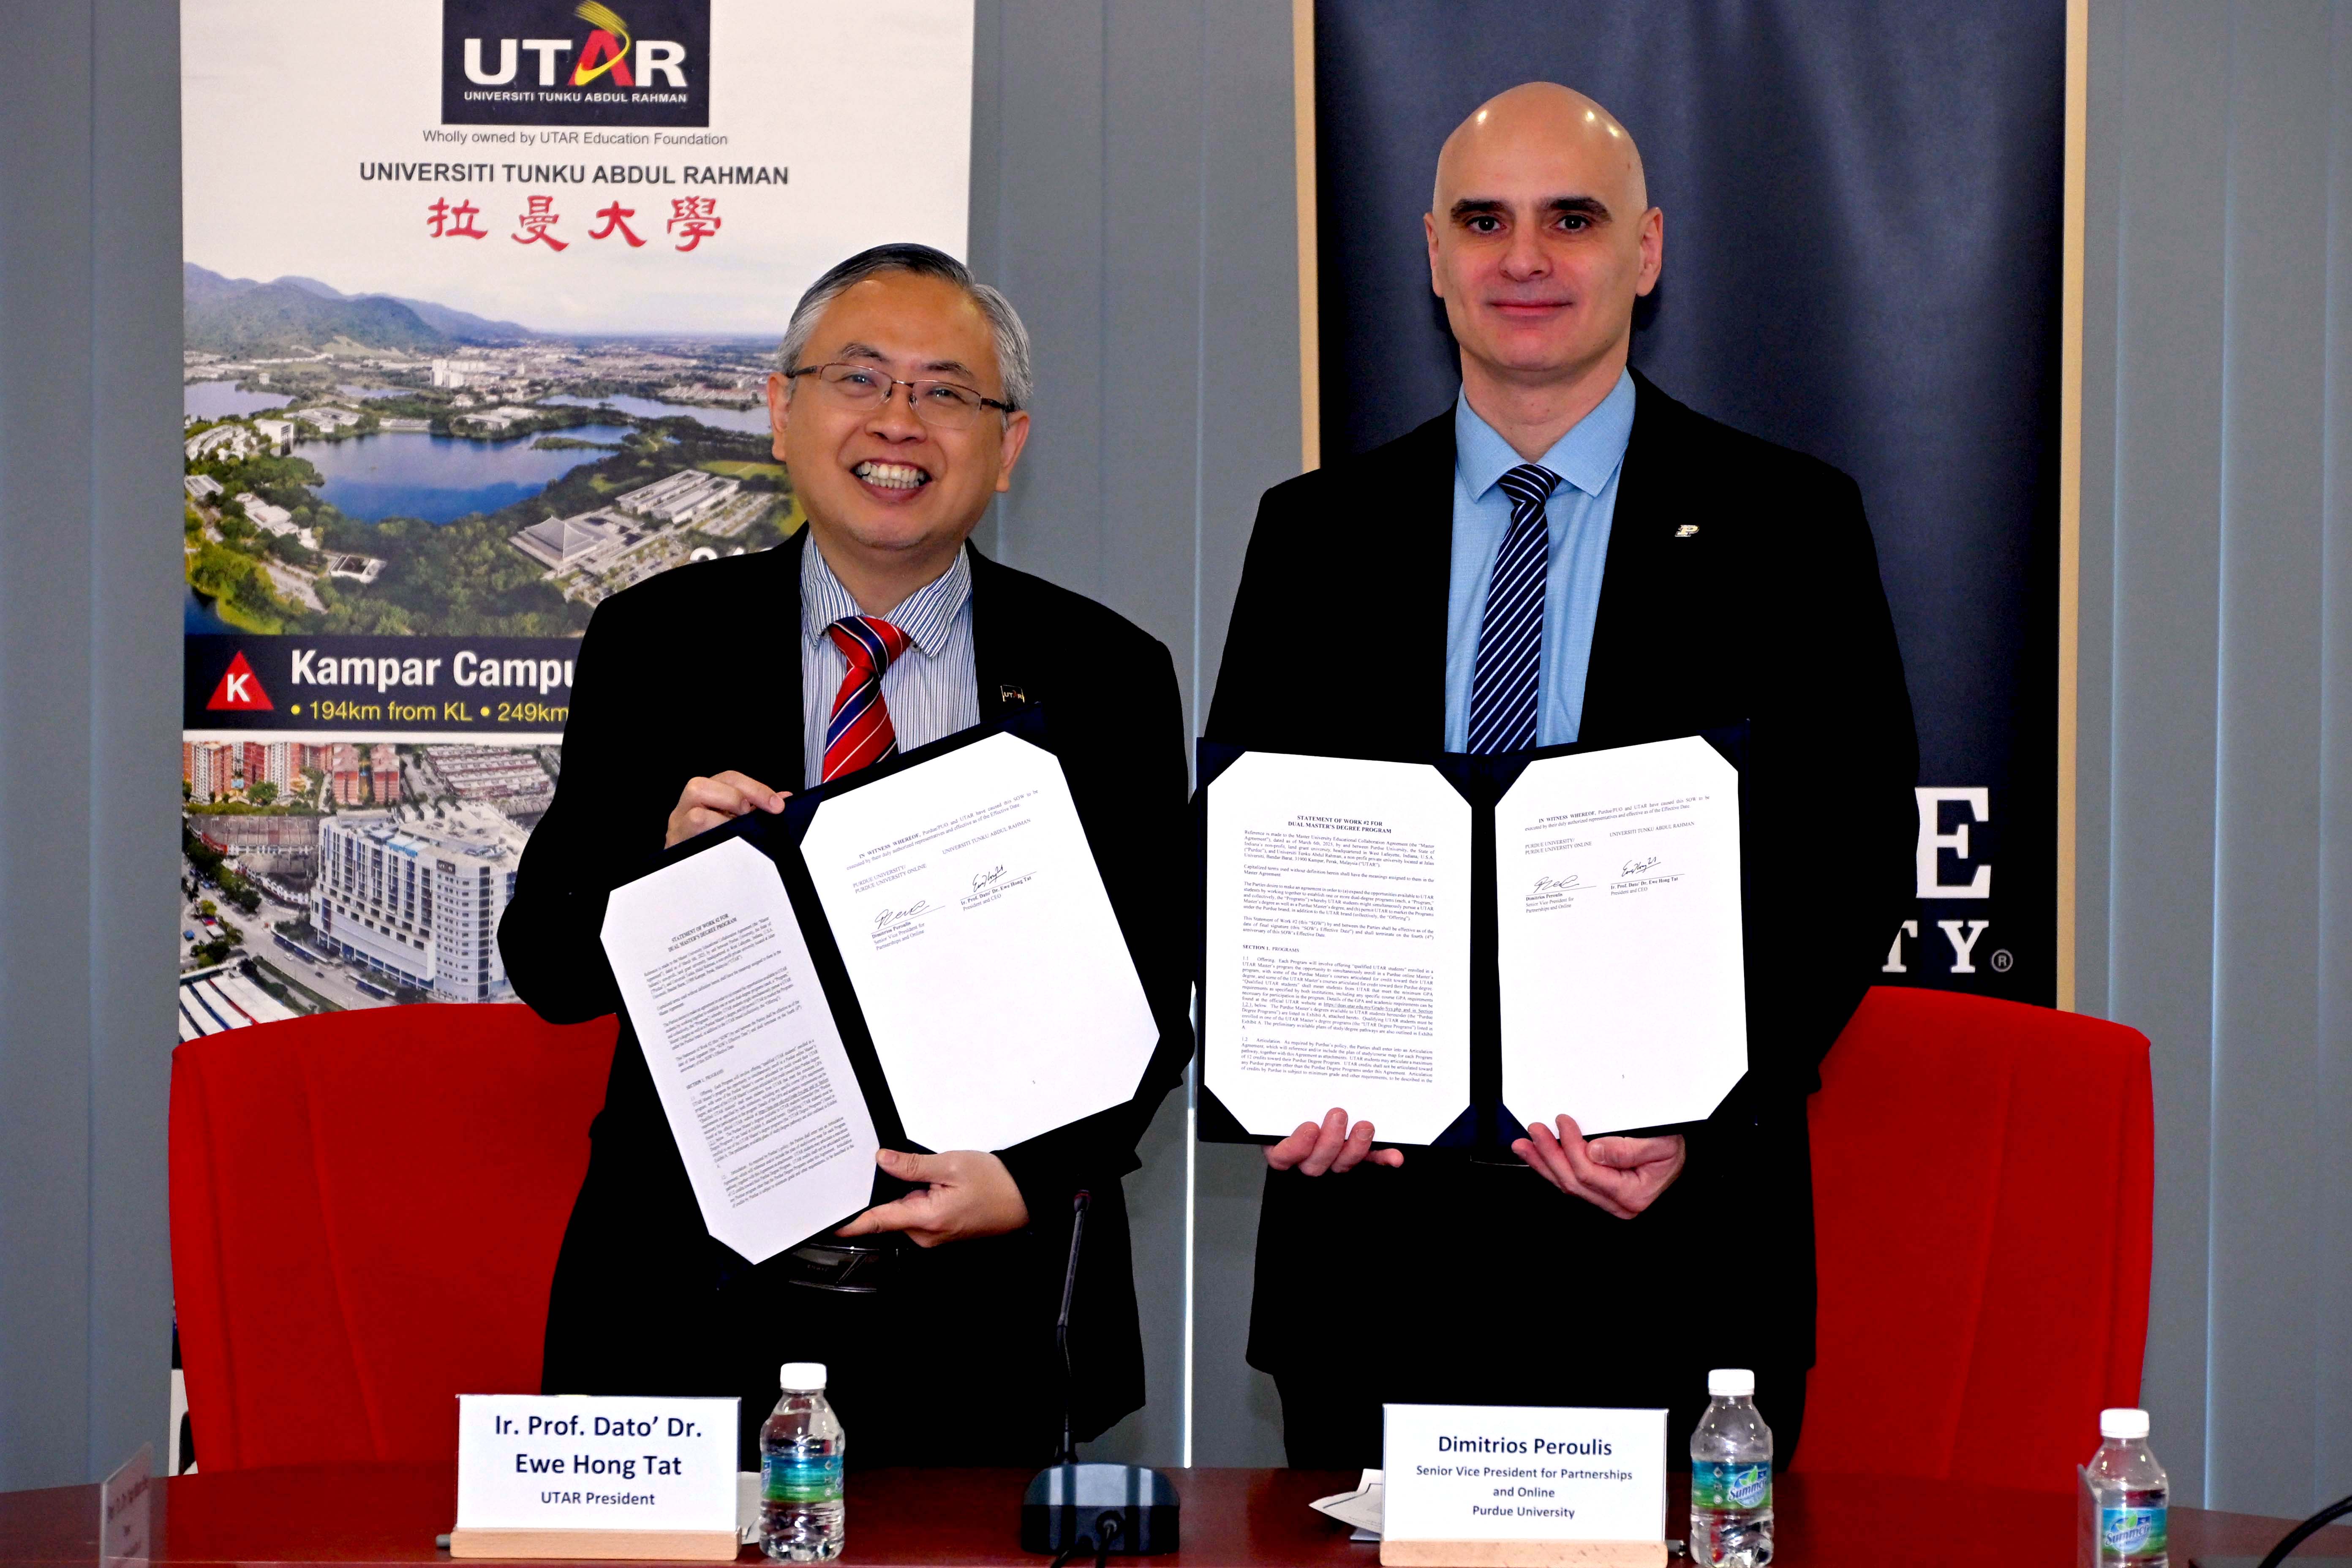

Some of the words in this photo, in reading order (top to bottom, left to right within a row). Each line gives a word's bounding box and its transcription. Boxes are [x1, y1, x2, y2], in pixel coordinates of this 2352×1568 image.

[464, 30, 687, 87] UTAR
[464, 91, 534, 101] UNIVERSITI
[538, 92, 581, 102] TUNKU
[584, 93, 628, 102] ABDUL
[632, 93, 686, 103] RAHMAN
[423, 130, 467, 145] Wholly
[472, 131, 515, 143] owned
[520, 132, 535, 146] by
[540, 131, 578, 144] UTAR
[584, 132, 649, 144] Education
[654, 133, 727, 145] Foundation
[360, 162, 493, 182] UNIVERSITI
[502, 164, 585, 183] TUNKU
[592, 165, 675, 184] ABDUL
[684, 166, 788, 184] RAHMAN
[427, 196, 721, 252] 拉曼大學
[291, 650, 441, 693] Kampar
[453, 651, 573, 694] Campu
[227, 673, 250, 702] K
[310, 701, 381, 720] 194km
[388, 701, 436, 721] from
[444, 702, 473, 721] KL
[498, 702, 569, 722] 249km
[1297, 815, 1333, 823] STATEMENT
[1588, 814, 1618, 822] representatives
[1609, 829, 1637, 837] UNIVERSITI
[1545, 844, 1573, 852] UNIVERSITY
[496, 1416, 519, 1435] Ir.
[528, 1415, 584, 1436] Prof.
[594, 1416, 658, 1437] Dato'
[668, 1418, 701, 1437] Dr.
[1439, 1436, 1527, 1454] Dimitrios
[1534, 1438, 1612, 1455] Peroulis
[516, 1454, 564, 1474] Ewe
[574, 1455, 636, 1480] Hong
[643, 1456, 681, 1475] Tat
[1417, 1465, 1452, 1475] Senior
[1456, 1467, 1480, 1476] Vice
[1484, 1467, 1537, 1478] President
[1541, 1468, 1557, 1478] for
[1561, 1469, 1632, 1481] Partnerships
[542, 1492, 580, 1503] UTAR
[586, 1492, 655, 1505] President
[1493, 1487, 1514, 1496] and
[1518, 1487, 1555, 1497] Online
[1473, 1505, 1513, 1516] Purdue
[1517, 1507, 1575, 1519] University
